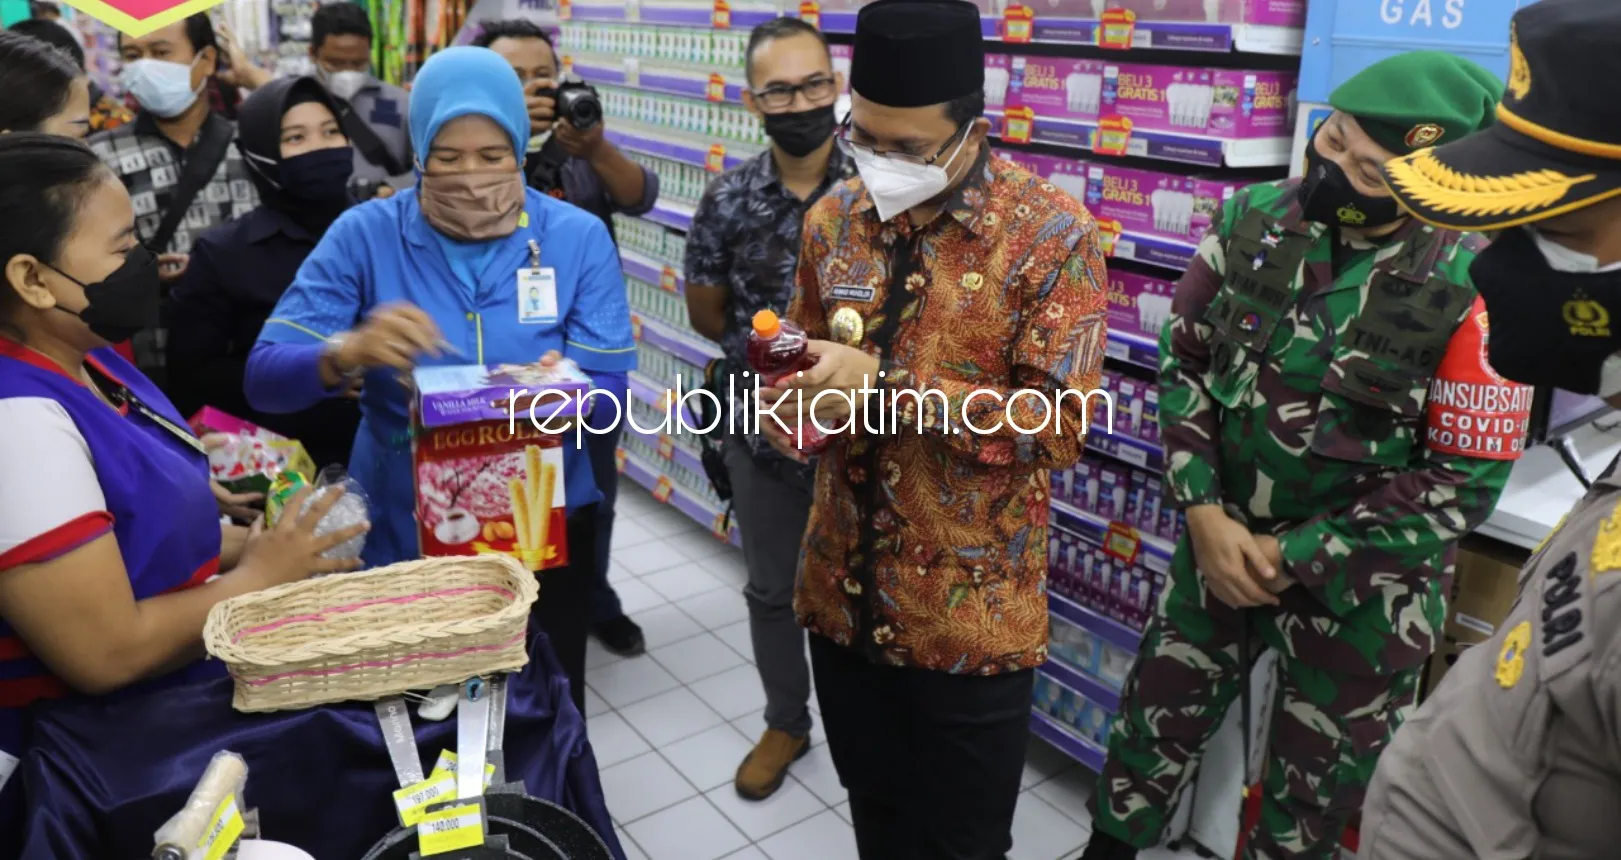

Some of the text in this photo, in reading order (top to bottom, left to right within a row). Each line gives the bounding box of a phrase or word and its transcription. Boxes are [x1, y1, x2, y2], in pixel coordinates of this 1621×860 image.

[1380, 0, 1465, 29] GAS
[1118, 72, 1153, 87] BELI 3
[1116, 86, 1165, 102] GRATIS 1
[1103, 175, 1138, 191] BELI 3
[1102, 188, 1150, 207] GRATIS 1
[1427, 427, 1503, 452] KODIM
[1542, 551, 1584, 657] POLRI
